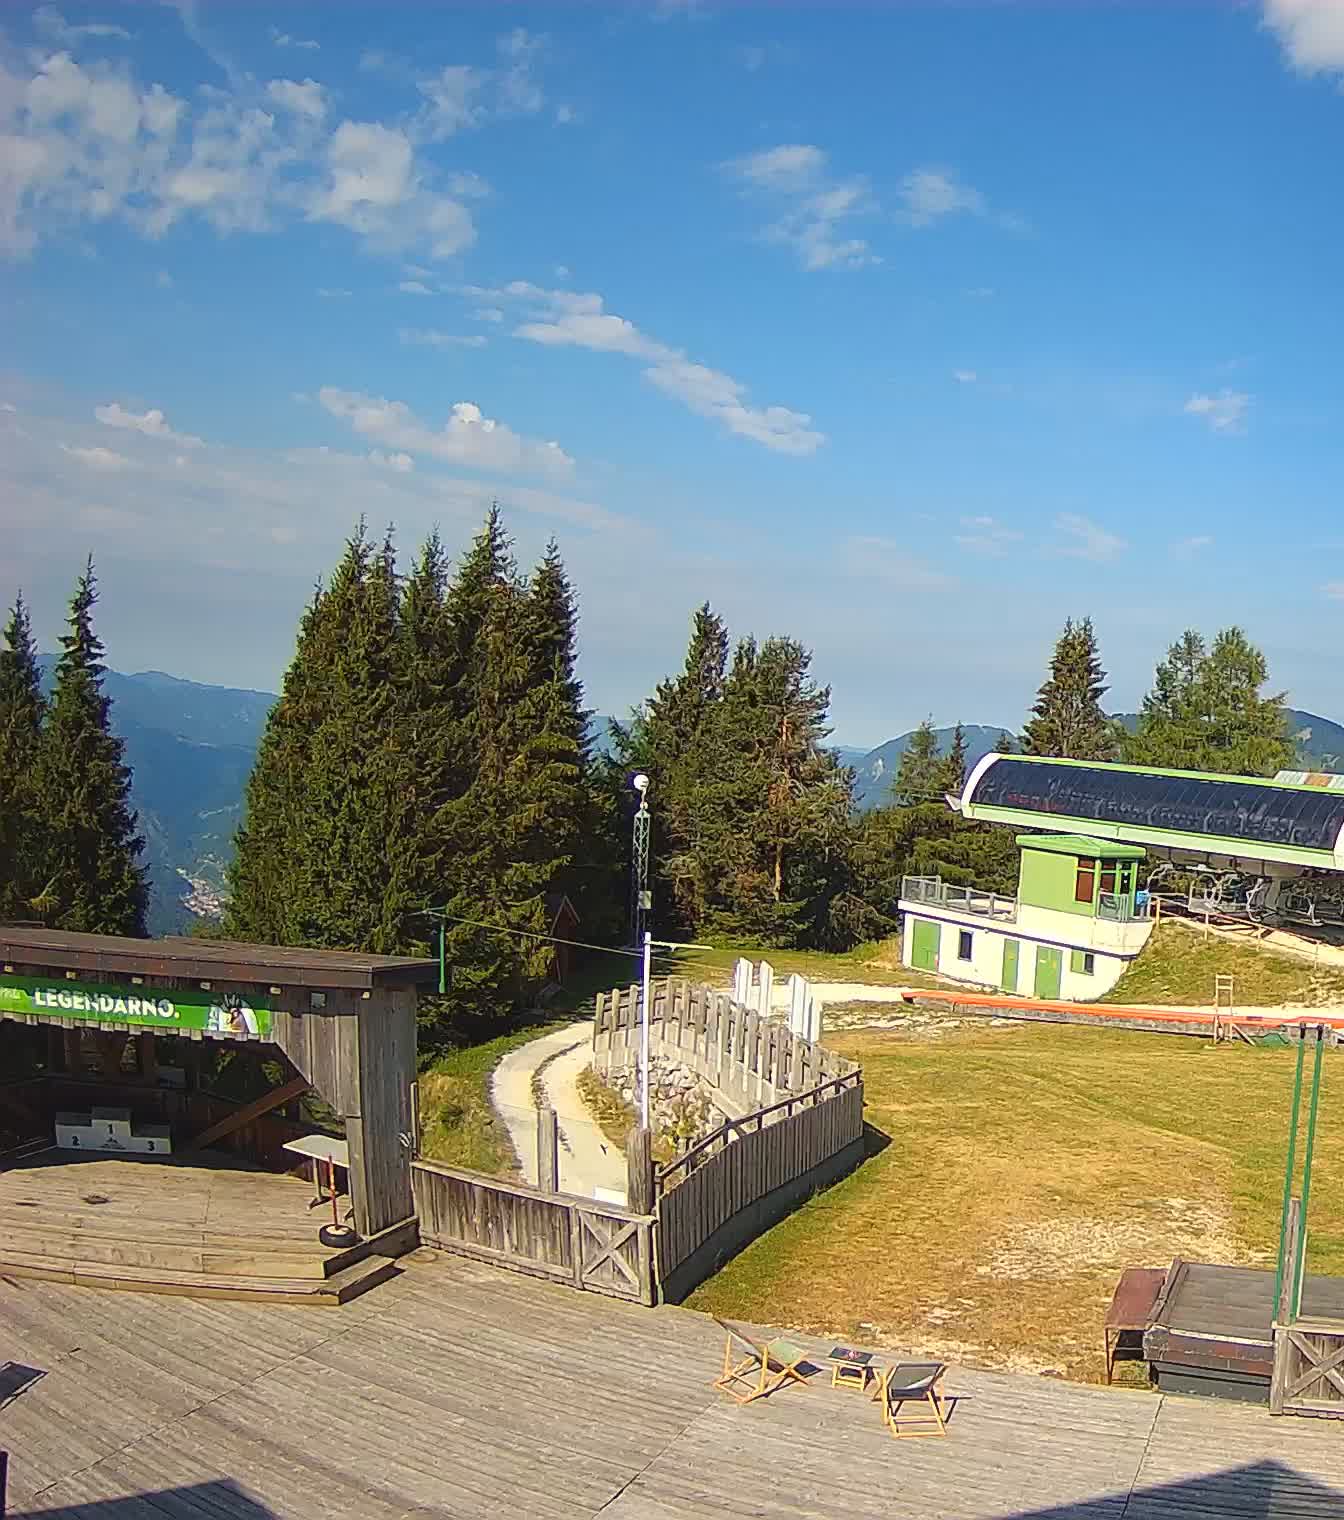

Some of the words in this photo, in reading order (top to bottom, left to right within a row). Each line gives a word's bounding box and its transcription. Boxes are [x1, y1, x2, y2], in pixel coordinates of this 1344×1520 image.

[34, 988, 181, 1018] LEGENDARNO.
[107, 1124, 114, 1134] 1
[72, 1136, 80, 1146] 2
[147, 1141, 155, 1151] 3
